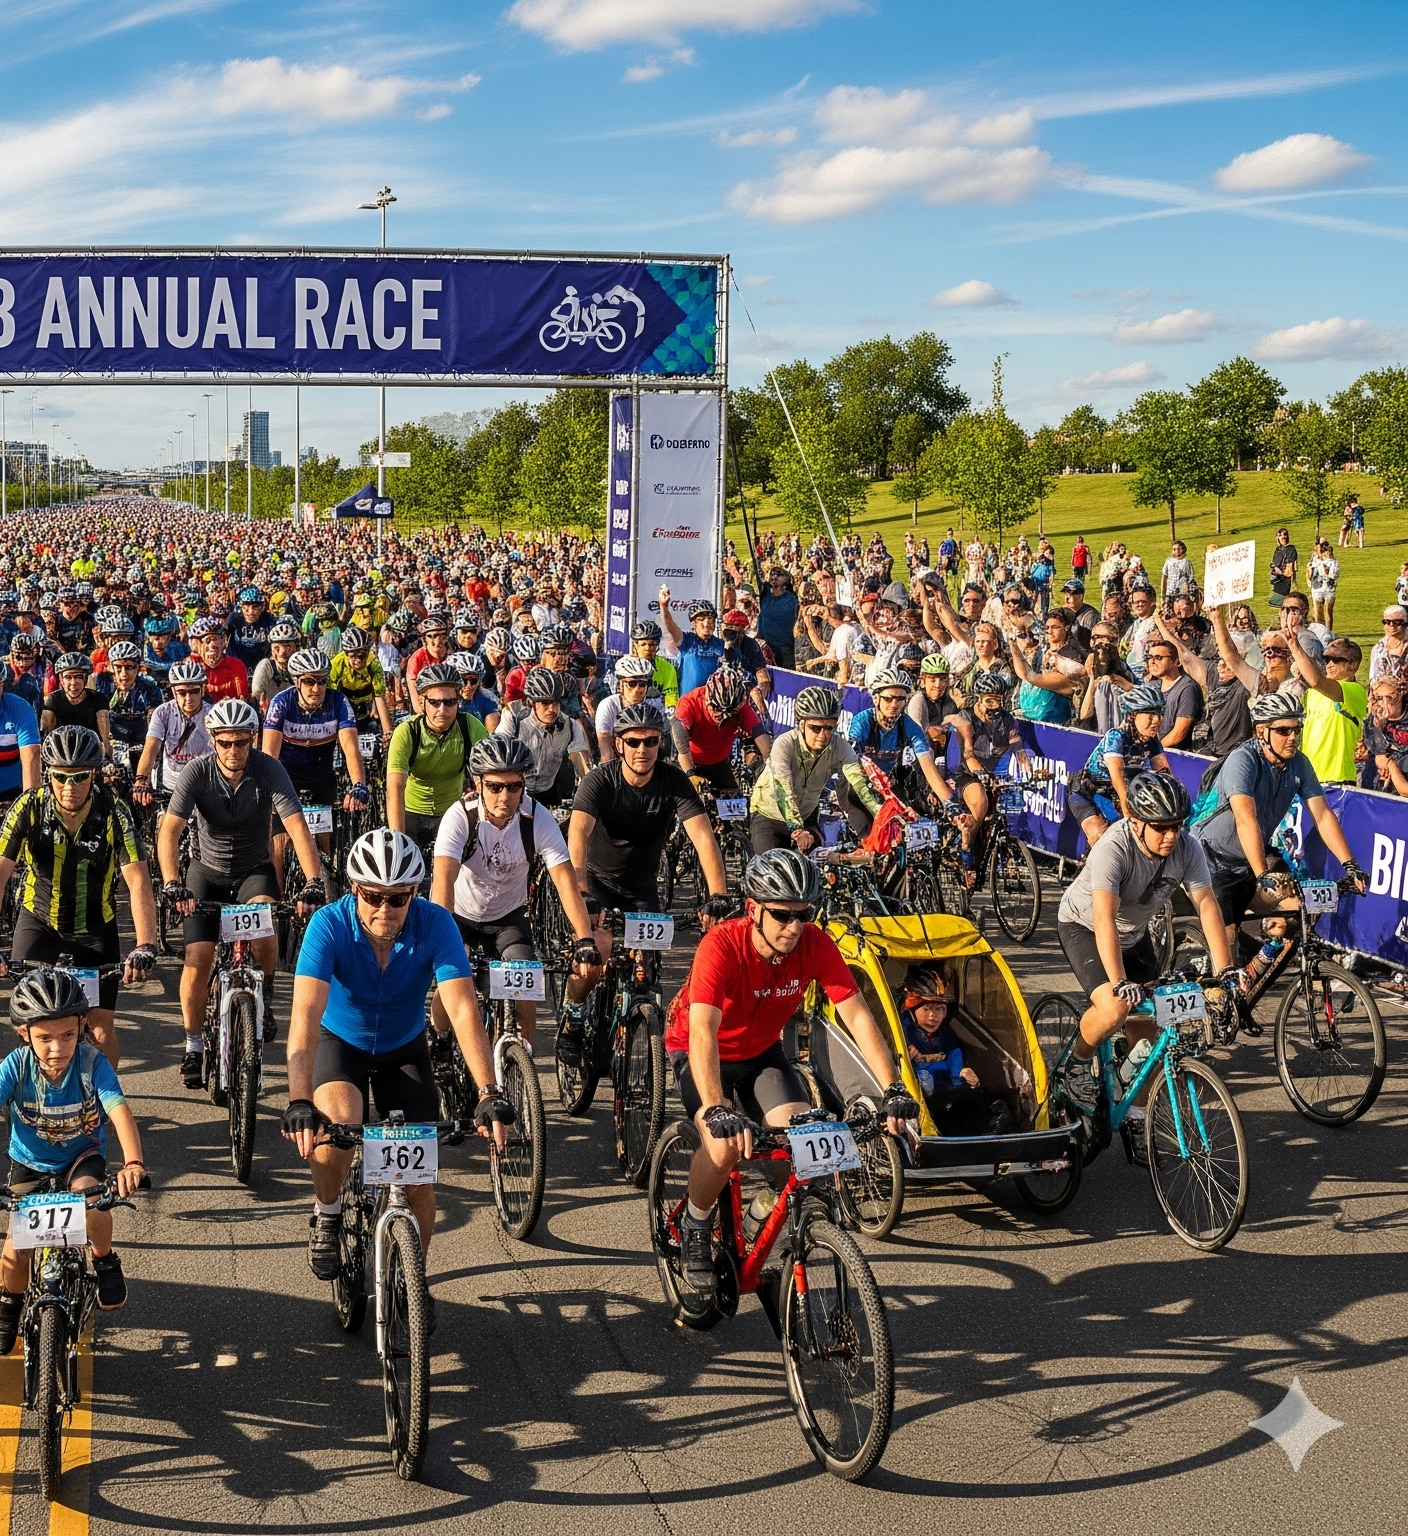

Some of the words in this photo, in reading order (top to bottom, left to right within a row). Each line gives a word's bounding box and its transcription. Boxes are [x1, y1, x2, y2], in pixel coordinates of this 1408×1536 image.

[35, 275, 276, 350] ANNUAL
[294, 277, 442, 350] RACE
[1369, 832, 1408, 911] BI
